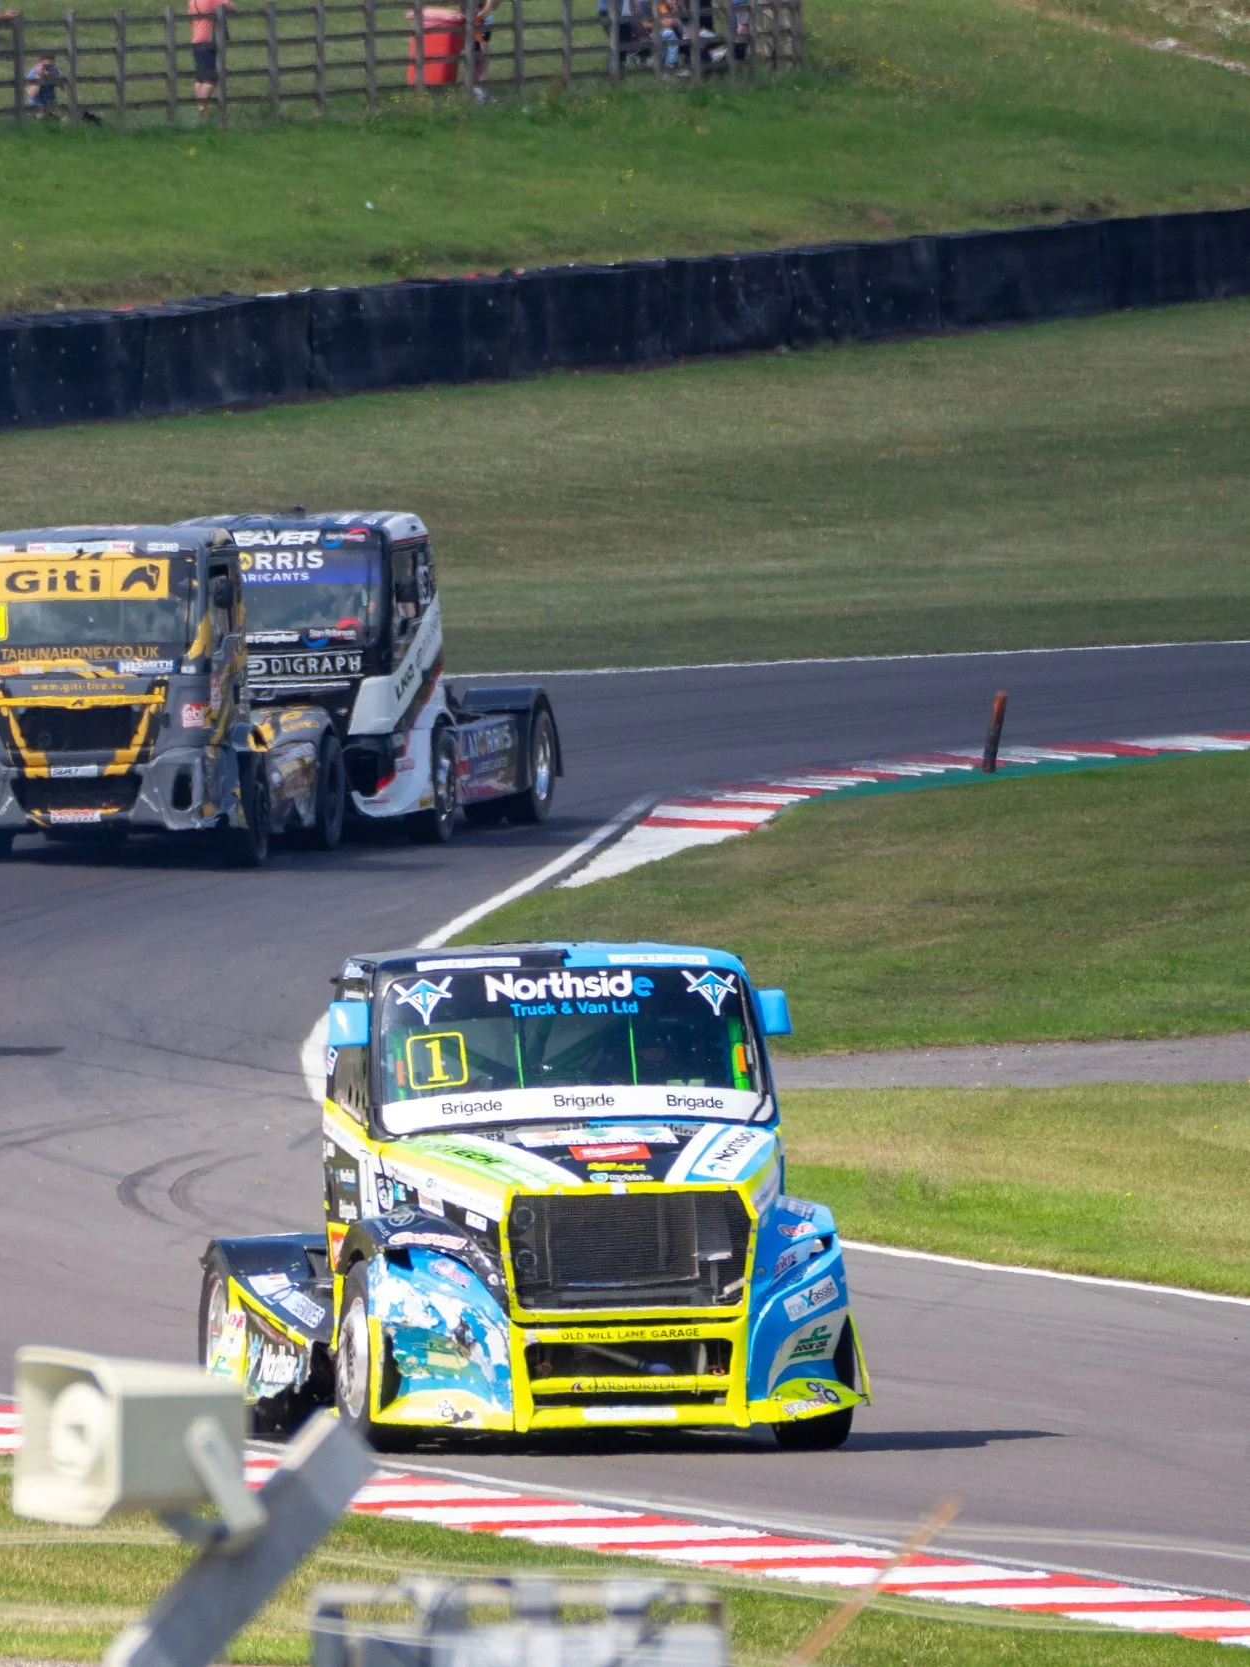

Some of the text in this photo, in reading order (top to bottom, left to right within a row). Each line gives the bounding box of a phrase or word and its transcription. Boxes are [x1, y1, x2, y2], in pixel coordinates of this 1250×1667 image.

[6, 568, 100, 593] Giti
[0, 646, 159, 661] TAHUNAHONEY.CO.UK
[271, 655, 361, 674] DIGRAPH
[31, 682, 125, 693] www.giti-tire.eu
[485, 970, 655, 1001] Northside
[511, 1001, 639, 1017] Truck & Van Ltd
[425, 1040, 450, 1082] 1
[441, 1093, 724, 1116] Brigade Brigade Brigade
[562, 1328, 700, 1340] OLD MILL LANE GARAGE
